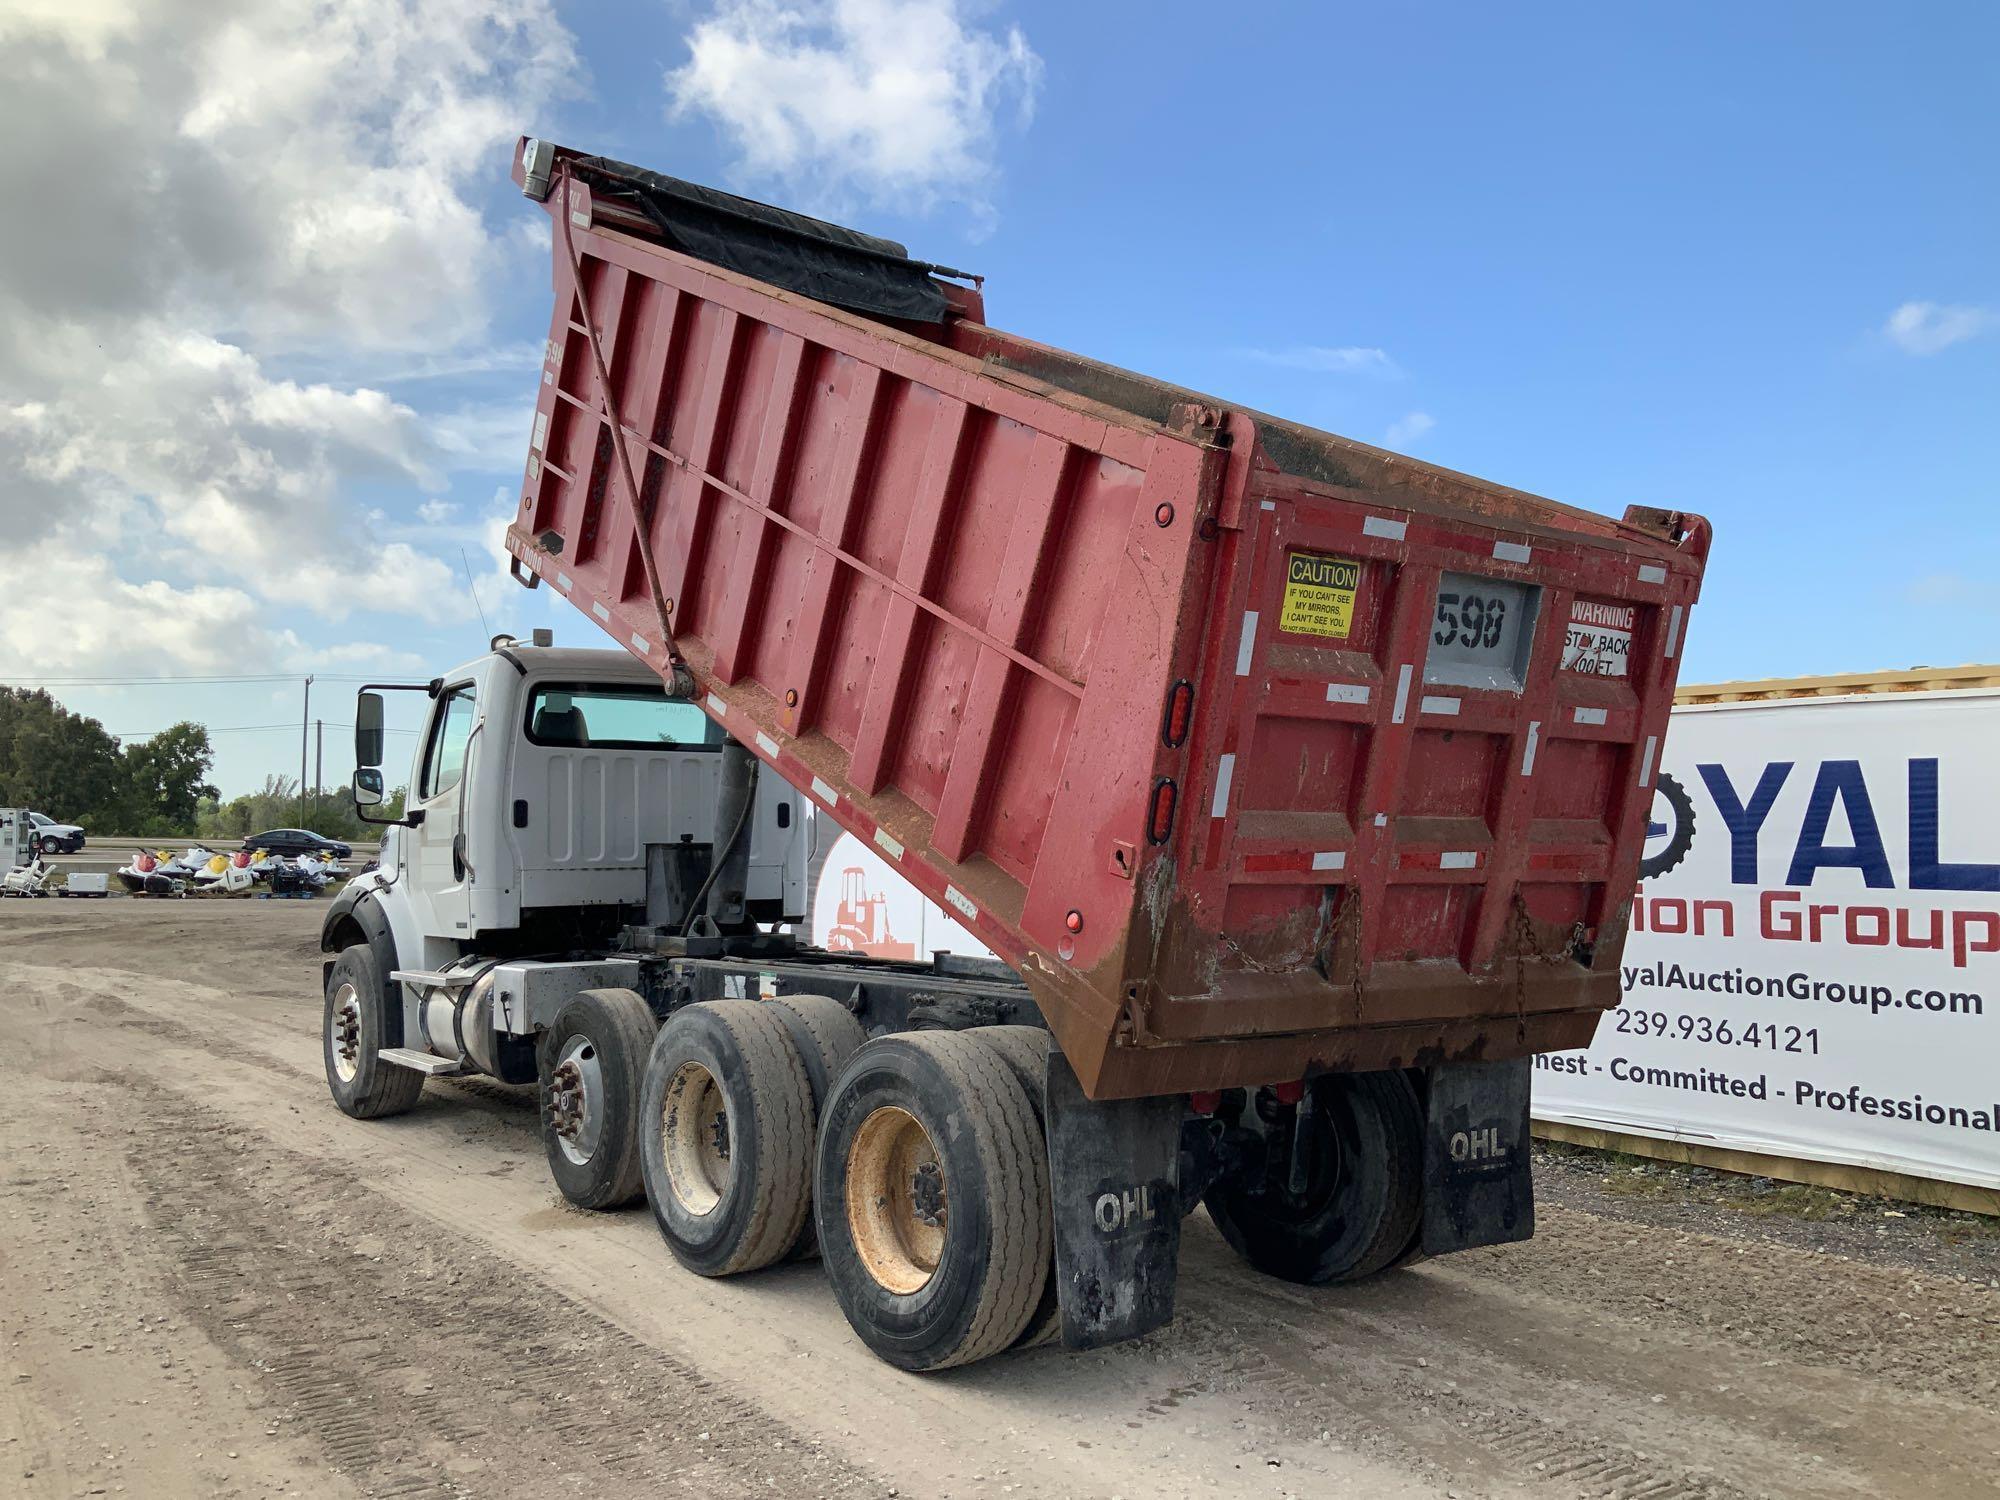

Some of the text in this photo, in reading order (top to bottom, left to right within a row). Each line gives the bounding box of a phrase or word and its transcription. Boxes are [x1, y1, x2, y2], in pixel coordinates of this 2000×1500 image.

[1291, 560, 1356, 587] CAUTION
[1289, 588, 1350, 604] IF YOU CAN'T SEE
[1295, 601, 1306, 610] MY
[1291, 613, 1312, 623] CAN'T
[1314, 616, 1327, 625] SEE
[1330, 618, 1345, 628] YOU.
[1434, 594, 1505, 648] 598
[1571, 601, 1634, 630] WARNING
[1599, 635, 1630, 656] BACK
[1574, 657, 1595, 675] 00
[1633, 882, 2000, 968] ion Group
[1622, 961, 1983, 1015] yalAuctionGroup.com
[1616, 1008, 1819, 1054] 239.936.4121
[1531, 1053, 1588, 1075] nest
[1610, 1057, 1767, 1101] Committed
[1795, 1080, 2000, 1133] Professional
[1449, 1127, 1506, 1161] OHL
[1095, 1186, 1155, 1232] OHL
